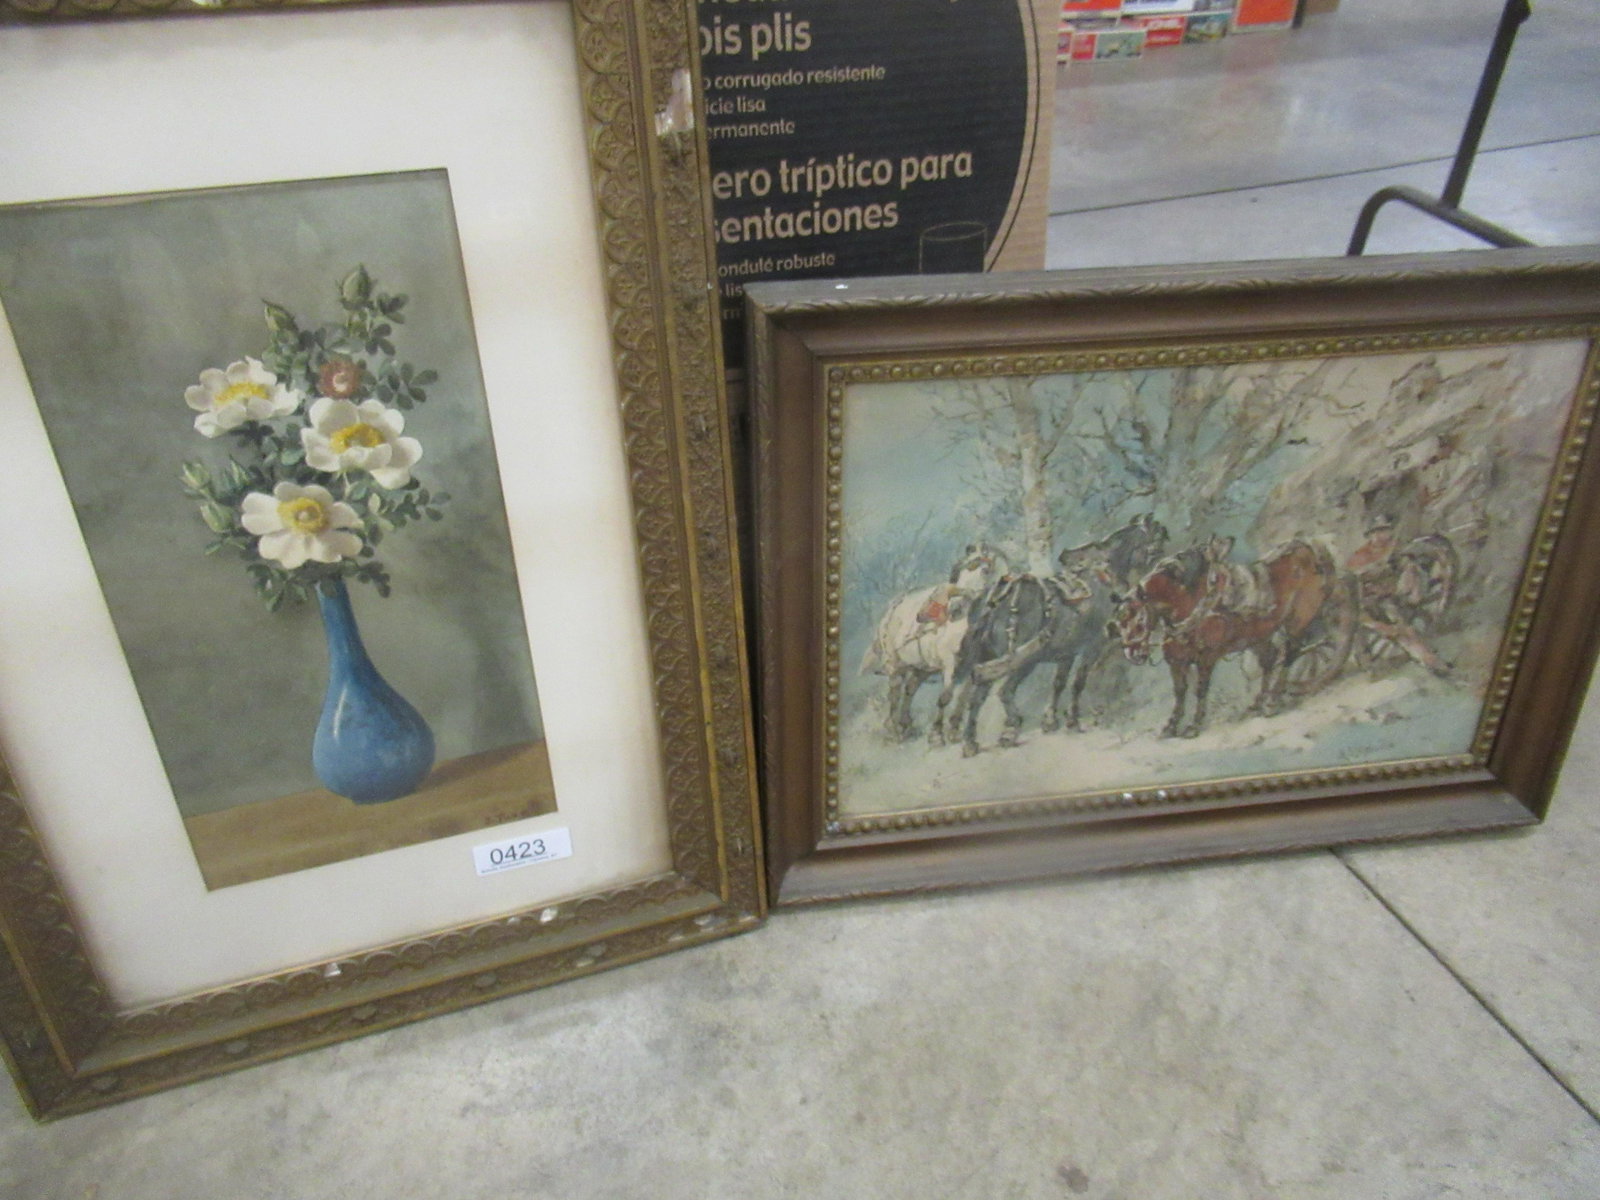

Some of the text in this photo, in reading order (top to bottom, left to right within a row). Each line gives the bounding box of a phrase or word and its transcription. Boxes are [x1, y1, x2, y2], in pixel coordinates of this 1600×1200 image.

[751, 12, 812, 61] plis
[715, 69, 803, 91] corrugado
[807, 64, 886, 84] resistente
[737, 96, 766, 113] lisa
[712, 152, 972, 200] ero tríptico para
[718, 252, 835, 277] ondulé robuste
[490, 839, 546, 865] 0423
